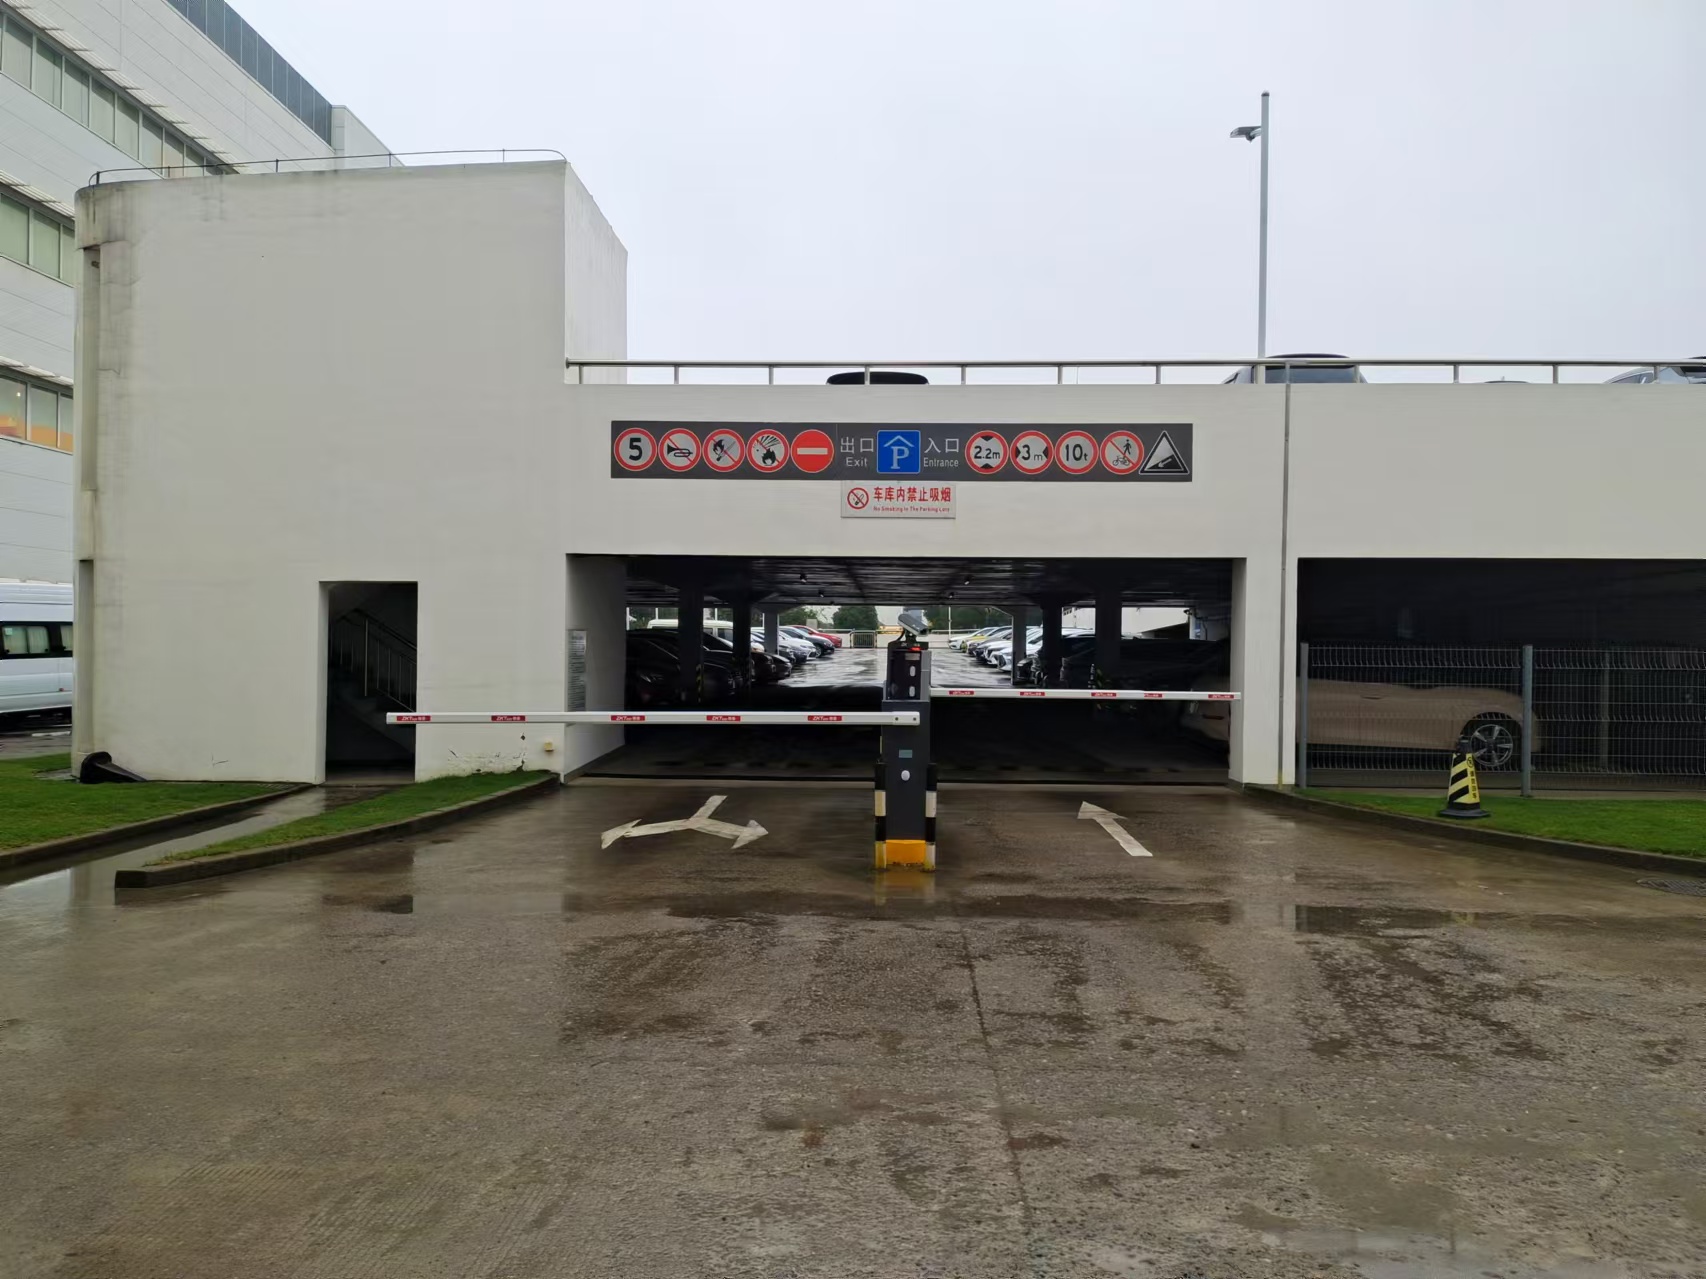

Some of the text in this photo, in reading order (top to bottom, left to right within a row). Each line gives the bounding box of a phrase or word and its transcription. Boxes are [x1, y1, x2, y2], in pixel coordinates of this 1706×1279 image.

[629, 438, 643, 461] 5
[840, 436, 874, 454] 出口
[924, 437, 960, 453] 入口
[973, 445, 1001, 460] 2.2m
[1065, 443, 1088, 462] 10t
[845, 457, 868, 467] Exit
[891, 446, 909, 469] P
[923, 457, 959, 468] Entrance
[873, 486, 951, 502] 车库内禁止吸烟
